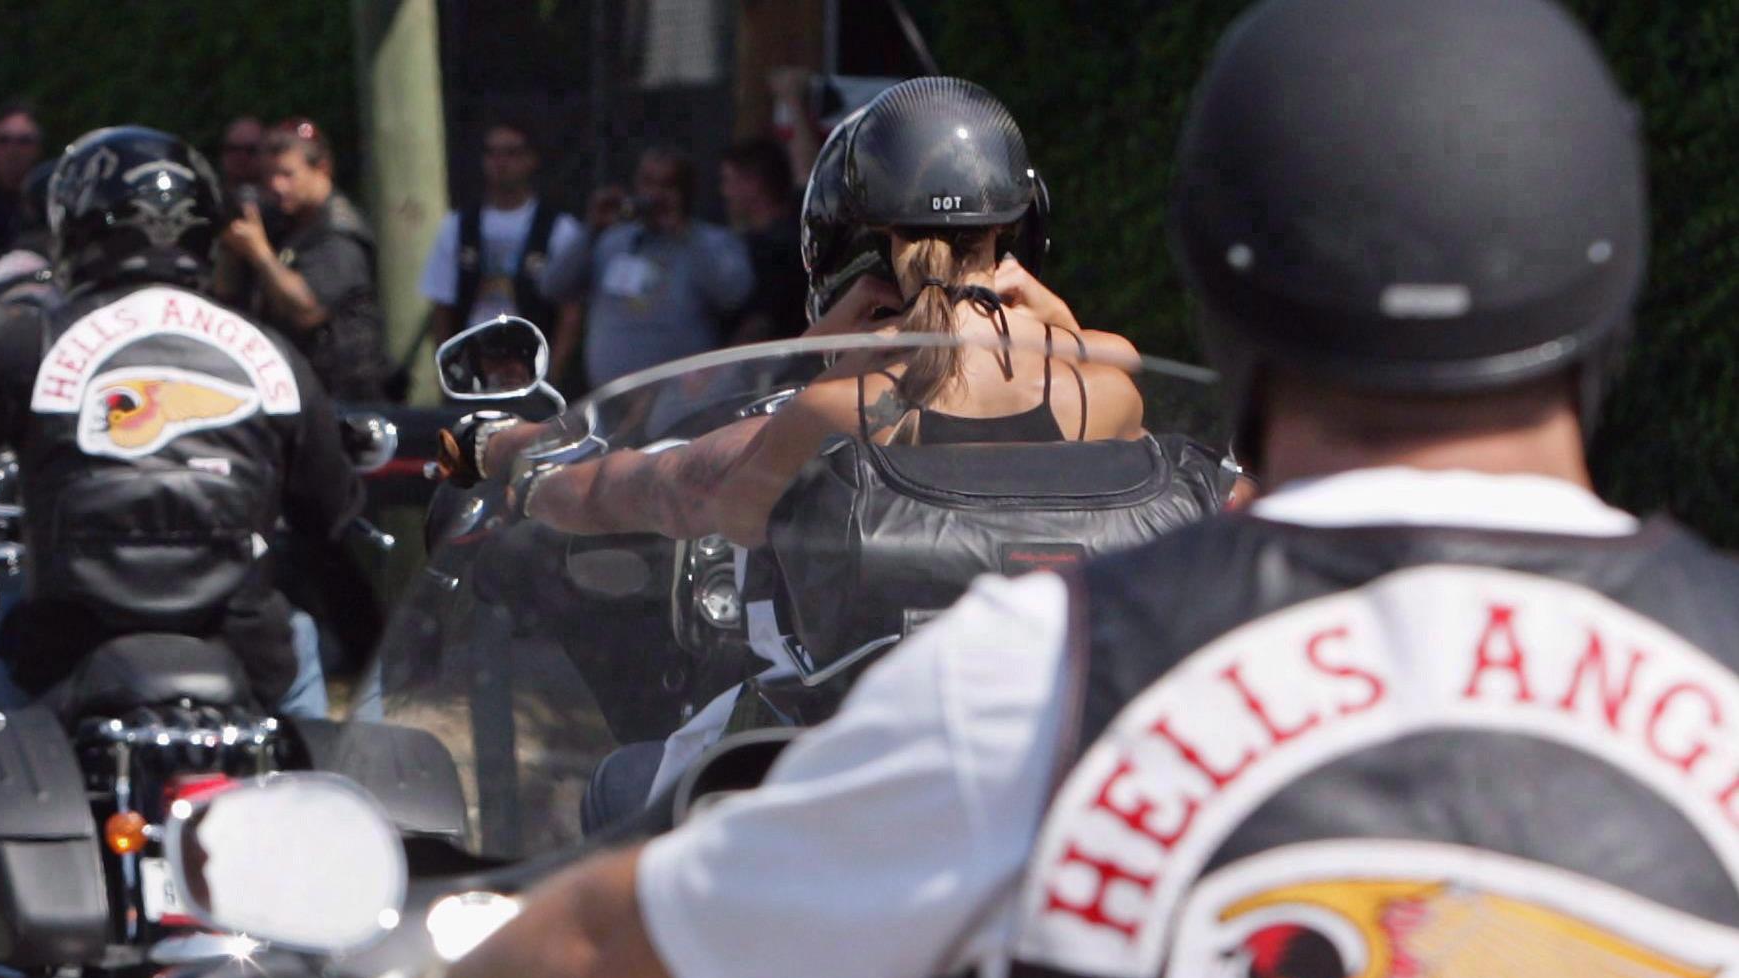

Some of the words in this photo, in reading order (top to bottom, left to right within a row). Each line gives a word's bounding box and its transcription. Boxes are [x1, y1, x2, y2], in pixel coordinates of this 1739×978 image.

[932, 196, 961, 210] DOT
[44, 308, 139, 402] HELLS
[162, 298, 290, 402] ANGELS
[1043, 626, 1386, 947] HELLS
[1462, 605, 1739, 823] ANG
